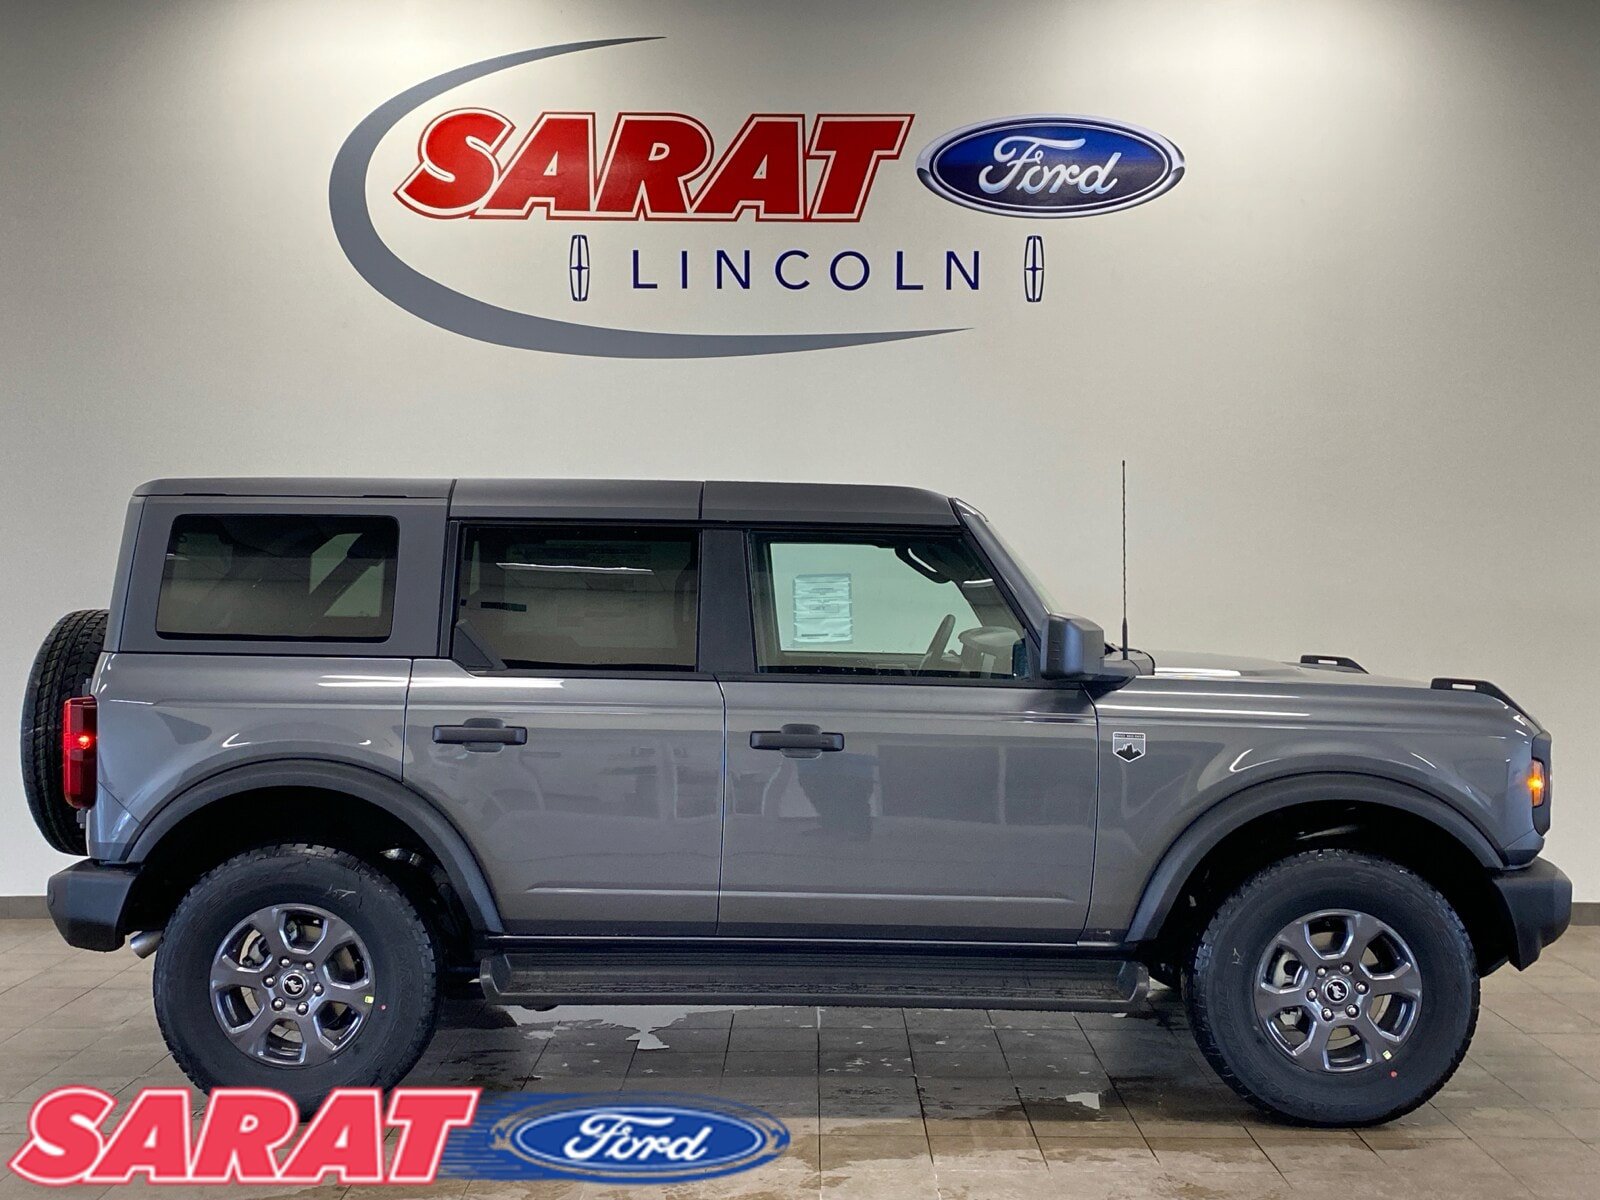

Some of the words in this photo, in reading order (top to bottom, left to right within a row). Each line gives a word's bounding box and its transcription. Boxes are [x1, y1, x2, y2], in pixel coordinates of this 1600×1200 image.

[393, 107, 914, 221] SARAT
[978, 135, 1122, 194] Ford
[632, 249, 980, 291] LINCOLN
